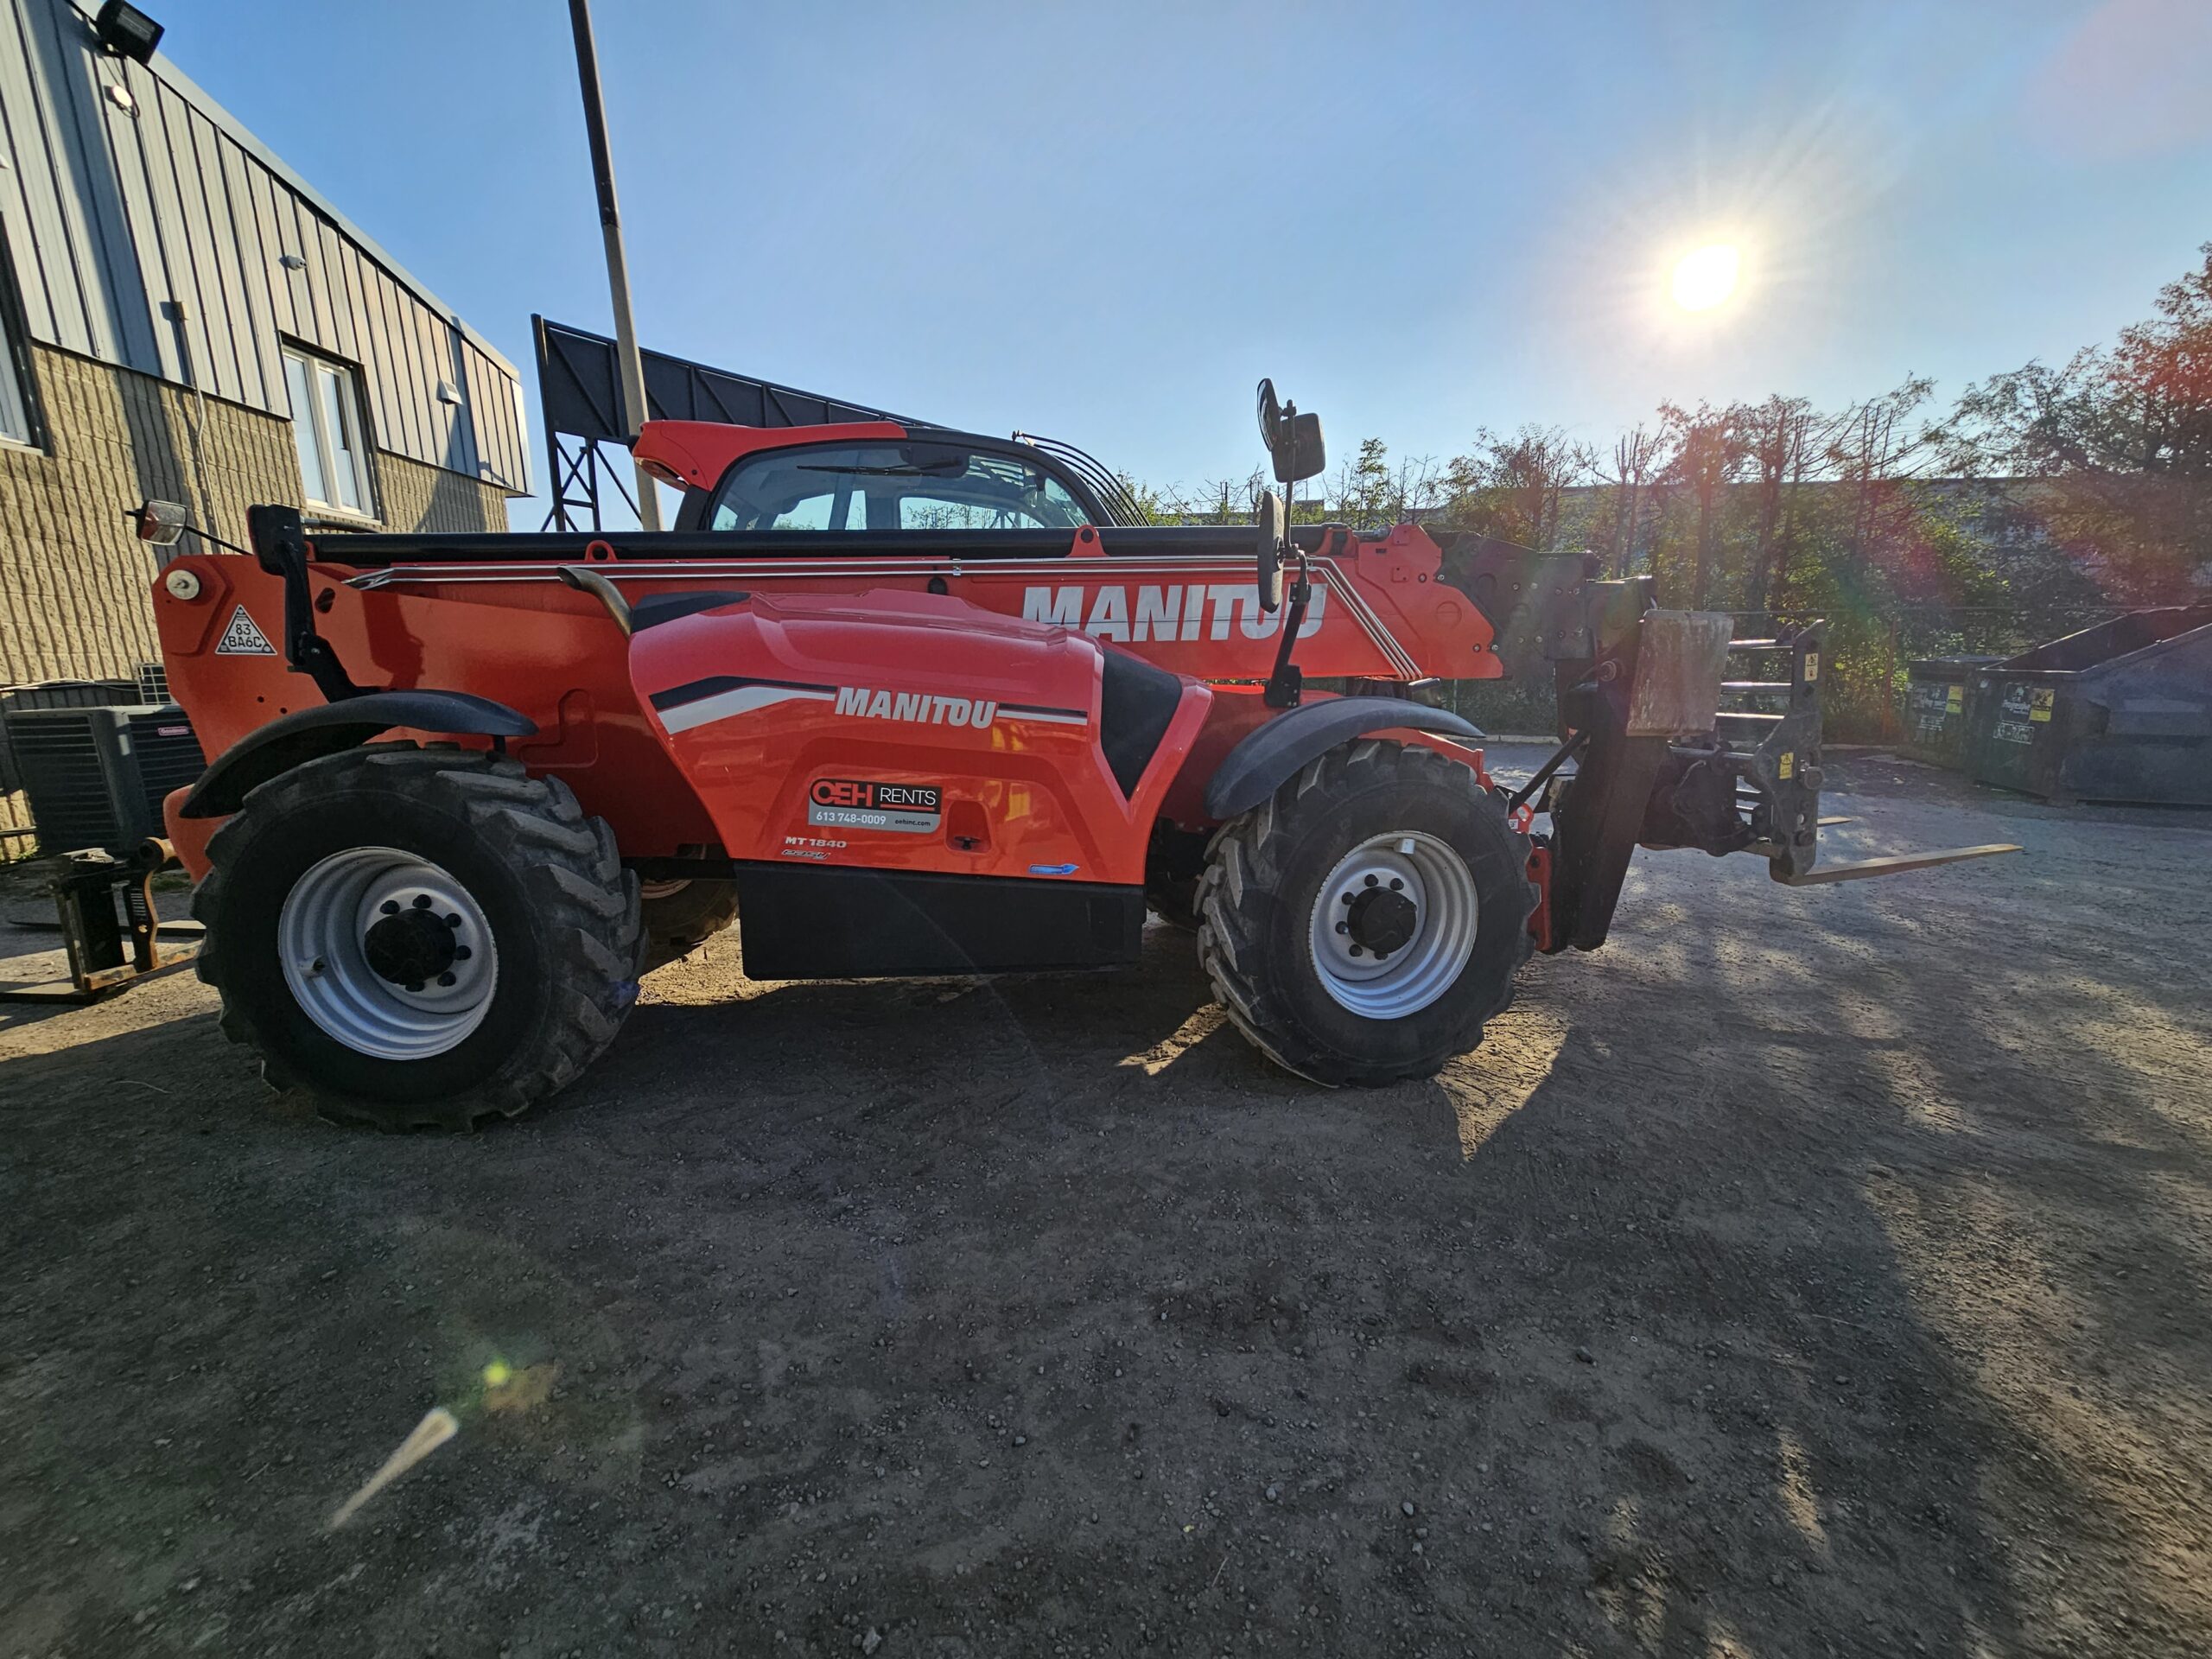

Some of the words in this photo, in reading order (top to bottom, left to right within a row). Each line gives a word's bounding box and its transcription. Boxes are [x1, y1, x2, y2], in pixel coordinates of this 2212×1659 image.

[1022, 584, 1328, 642] MANITOU
[236, 624, 251, 635] 83
[228, 636, 262, 648] BA6C
[835, 686, 997, 729] MANITOU
[812, 780, 874, 807] OEH
[880, 787, 937, 805] RENTS
[816, 811, 836, 822] 613
[837, 812, 887, 825] 748-0009
[785, 836, 807, 845] MT
[809, 838, 847, 849] 1840
